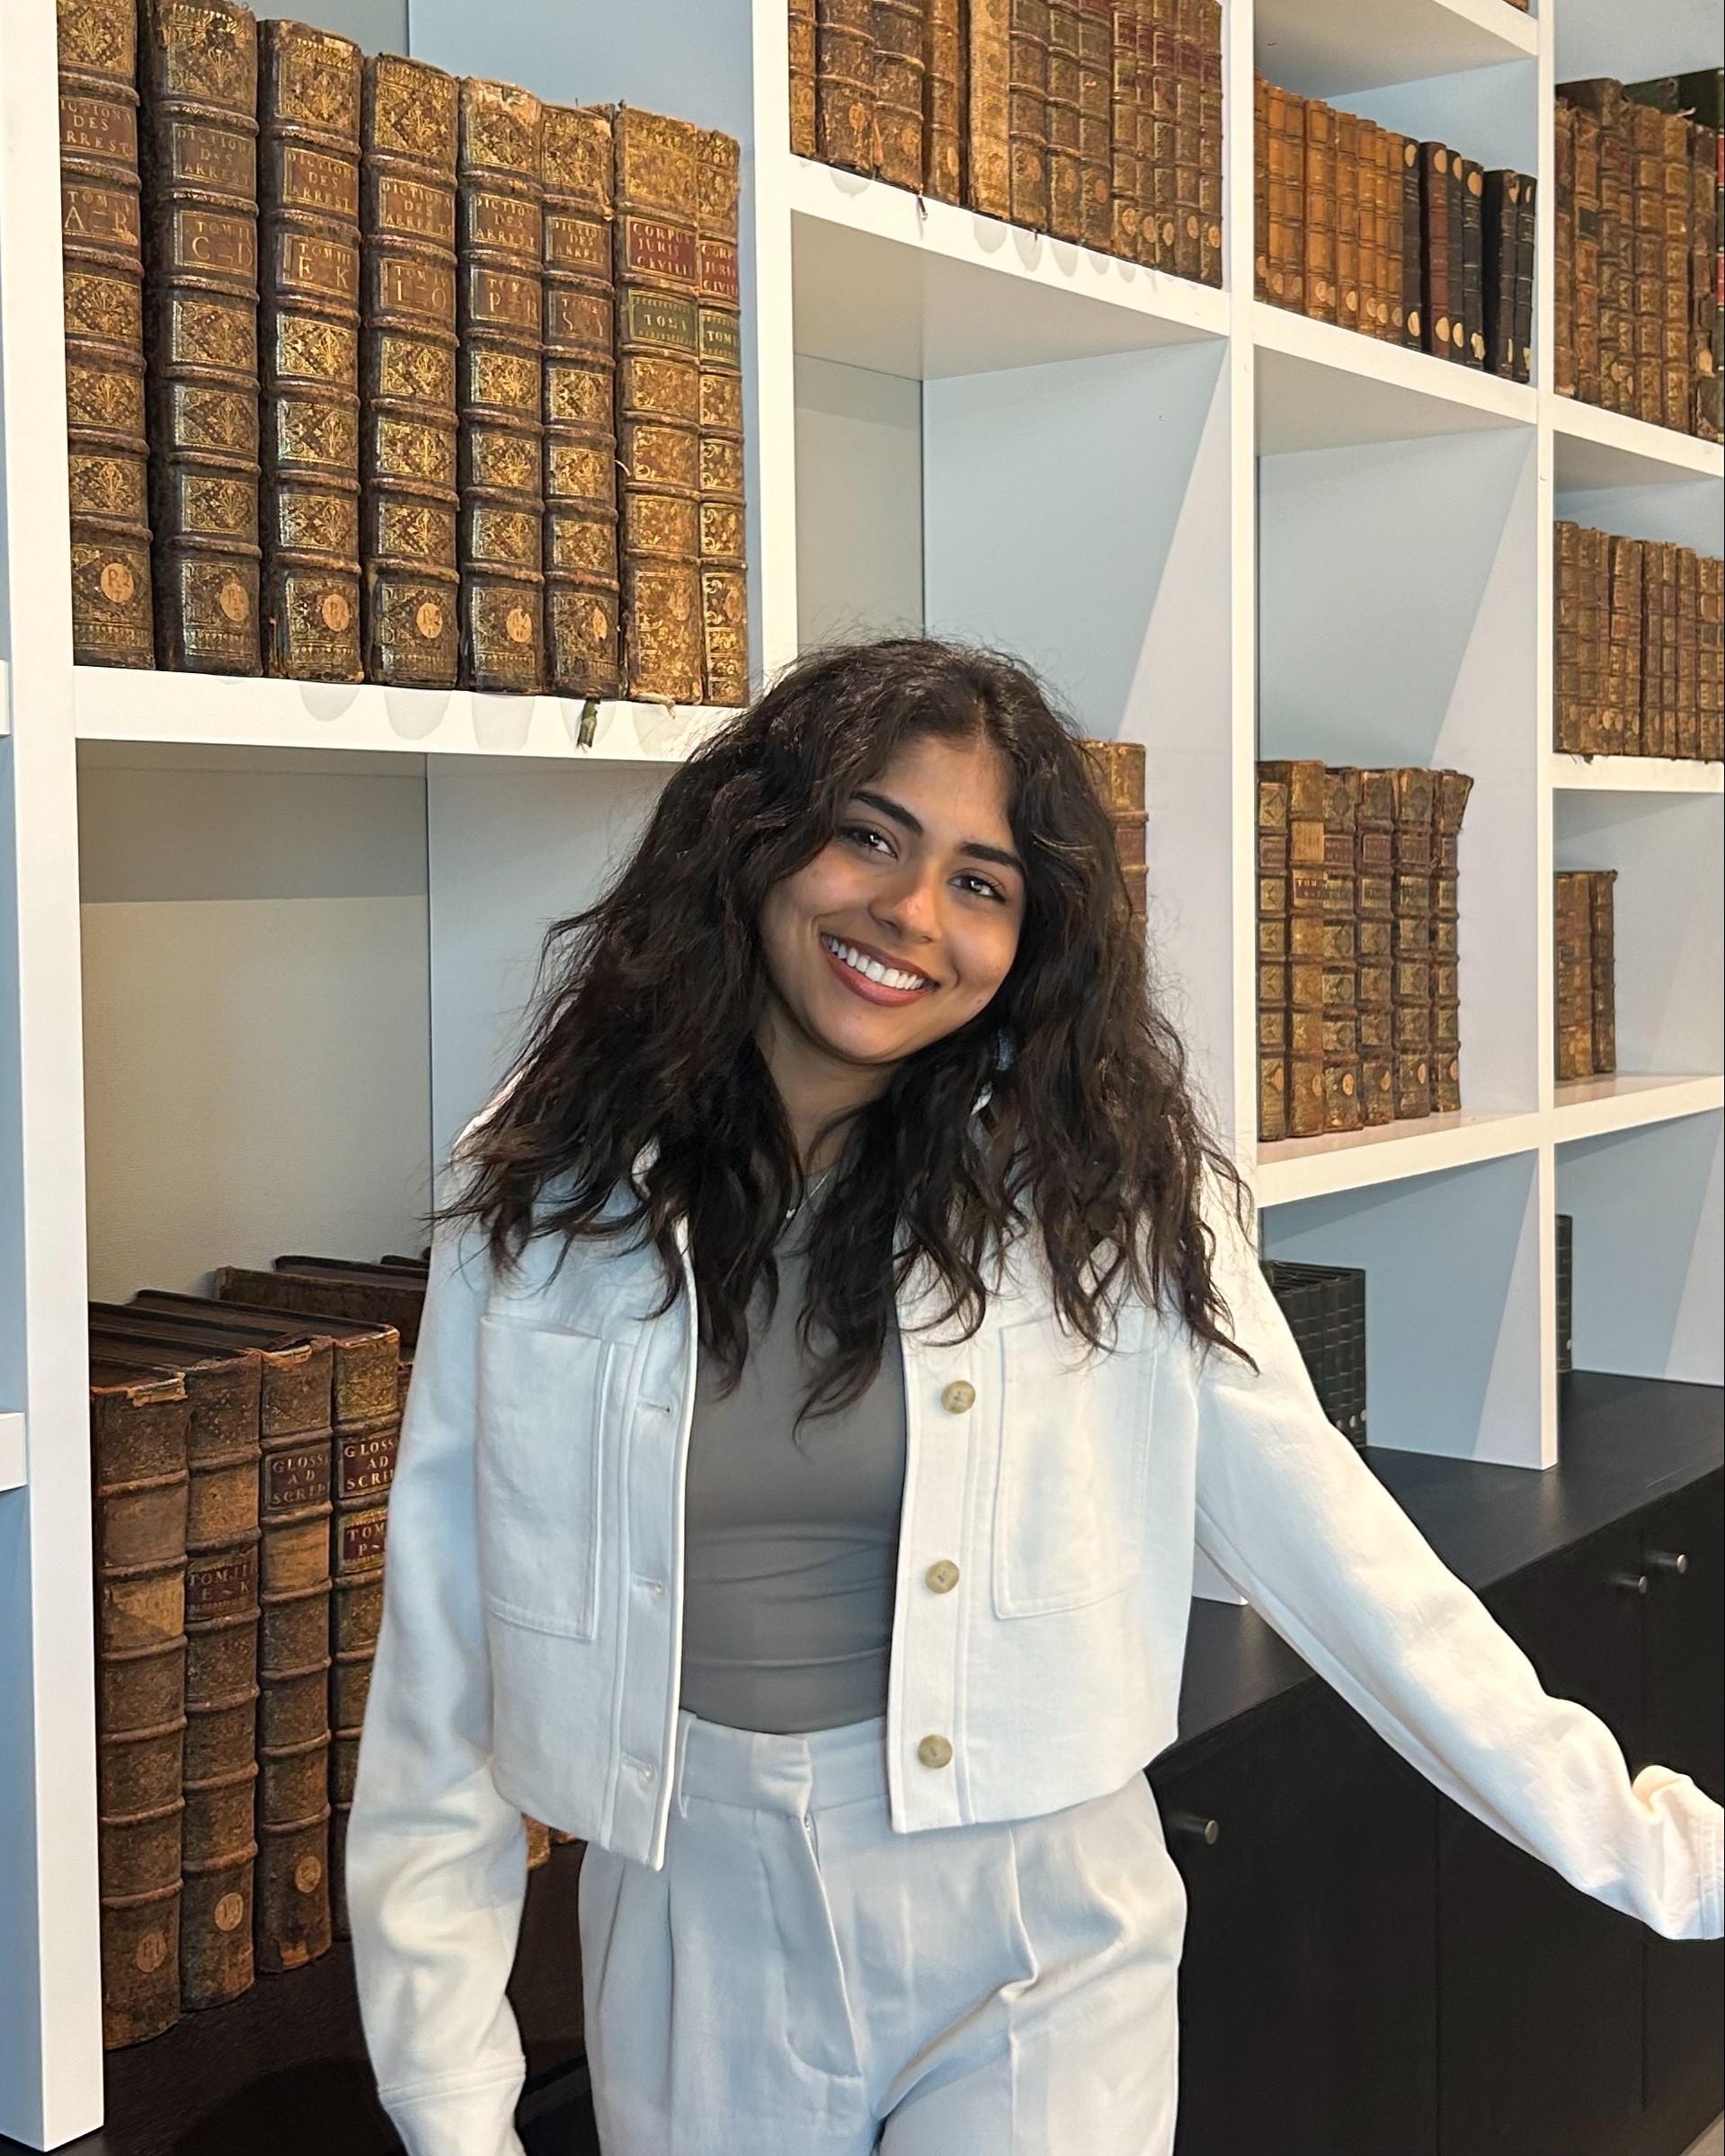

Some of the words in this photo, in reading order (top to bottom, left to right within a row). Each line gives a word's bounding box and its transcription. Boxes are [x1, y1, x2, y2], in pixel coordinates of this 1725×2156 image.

[73, 114, 109, 131] DES
[308, 172, 338, 189] DES
[191, 236, 210, 260] C
[298, 255, 314, 280] E
[336, 265, 350, 289] K
[344, 1439, 394, 1457] GLOSS
[367, 1455, 388, 1470] AD
